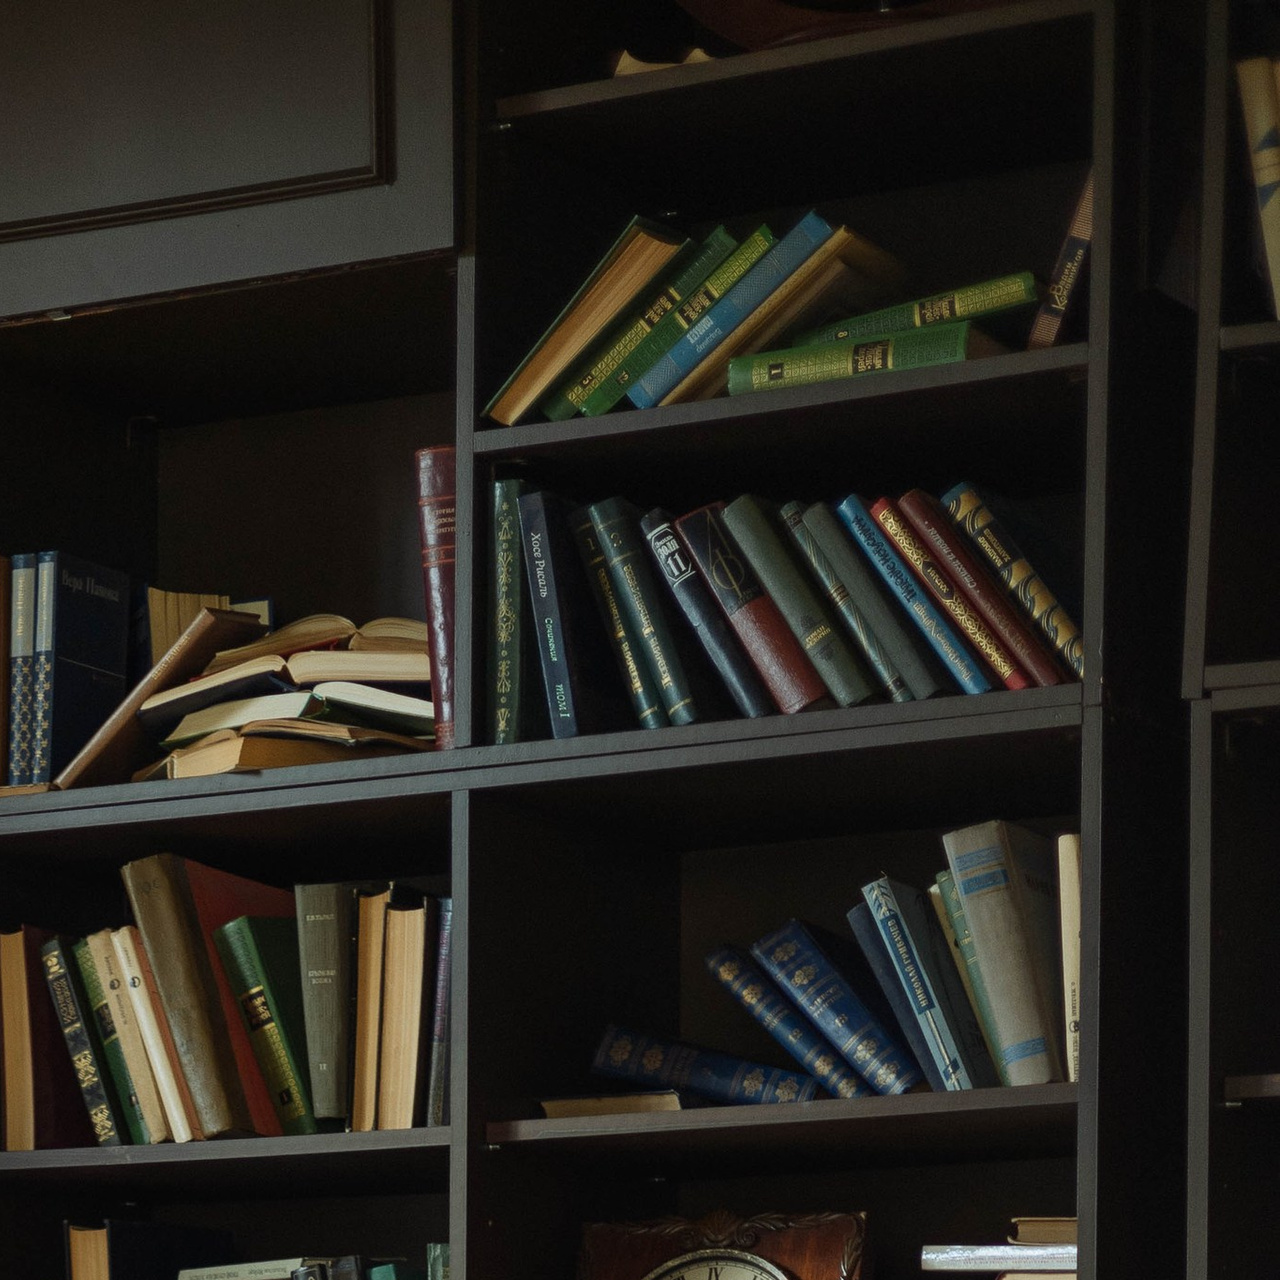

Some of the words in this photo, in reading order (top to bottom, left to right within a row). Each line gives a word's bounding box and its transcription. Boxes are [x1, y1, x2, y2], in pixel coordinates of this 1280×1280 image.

[529, 531, 544, 558] Хосе
[927, 525, 951, 555] поэмы
[532, 559, 551, 598] Рисаль
[665, 551, 688, 575] 11
[951, 558, 977, 589] Стихи
[542, 616, 560, 661] Сочинения
[554, 683, 567, 711] том
[885, 918, 912, 965] ГРИБАЧЕВ
[904, 964, 929, 1007] НИКОЛАЙ
